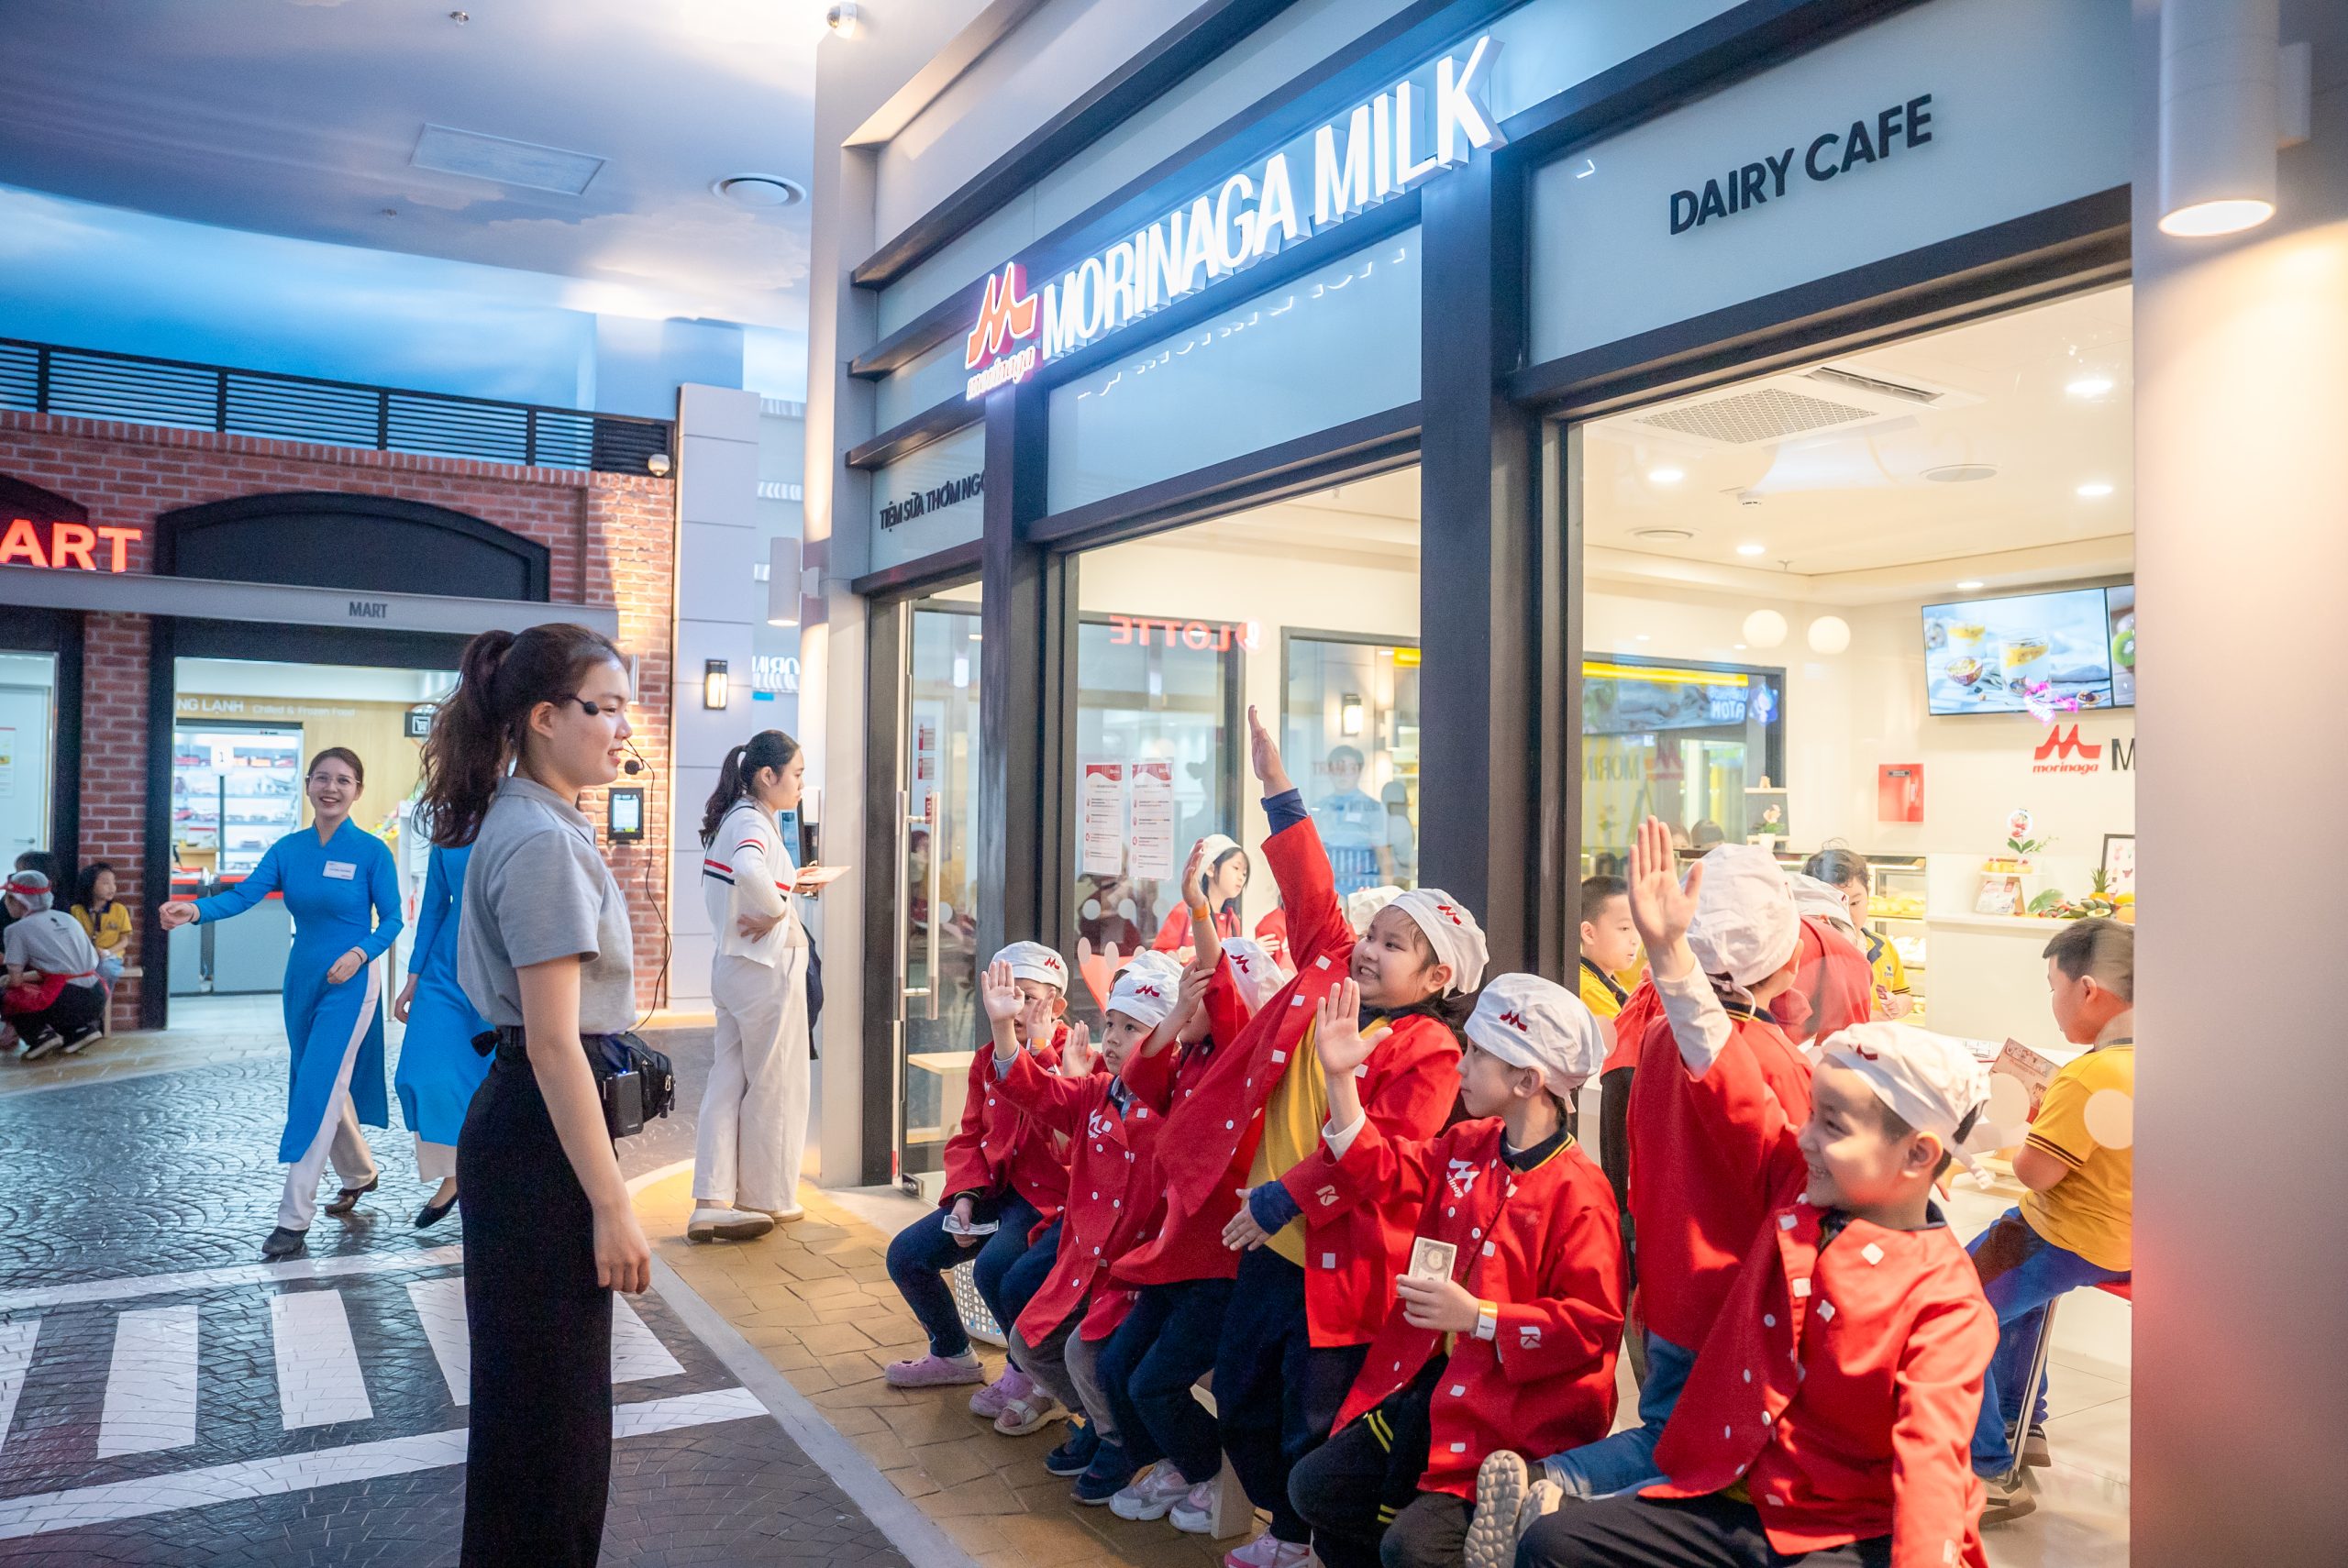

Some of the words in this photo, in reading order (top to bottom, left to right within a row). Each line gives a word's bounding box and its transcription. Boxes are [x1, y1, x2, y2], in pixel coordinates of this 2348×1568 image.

[1670, 147, 1795, 236] DAIRY
[1805, 93, 1933, 182] CAFE
[1042, 152, 1310, 361] MORINAGA
[1315, 35, 1507, 226] MILK
[0, 518, 143, 573] ART
[349, 602, 388, 619] MART
[2032, 760, 2100, 776] morinaga
